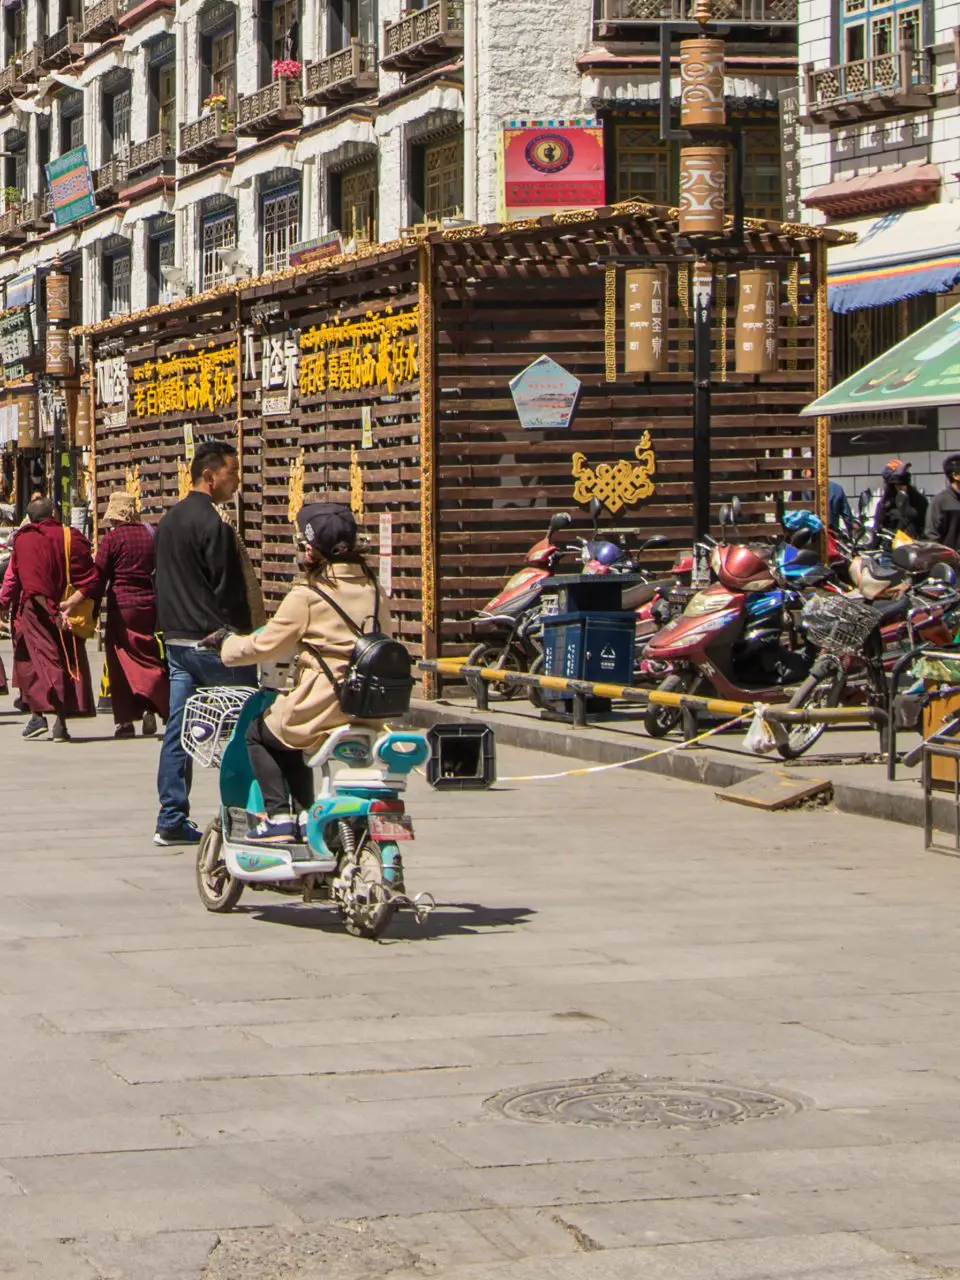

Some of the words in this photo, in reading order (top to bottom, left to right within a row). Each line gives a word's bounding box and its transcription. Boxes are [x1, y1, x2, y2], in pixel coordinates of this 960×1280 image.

[652, 281, 662, 359] 大昭圣泉
[765, 282, 776, 360] 大昭圣泉
